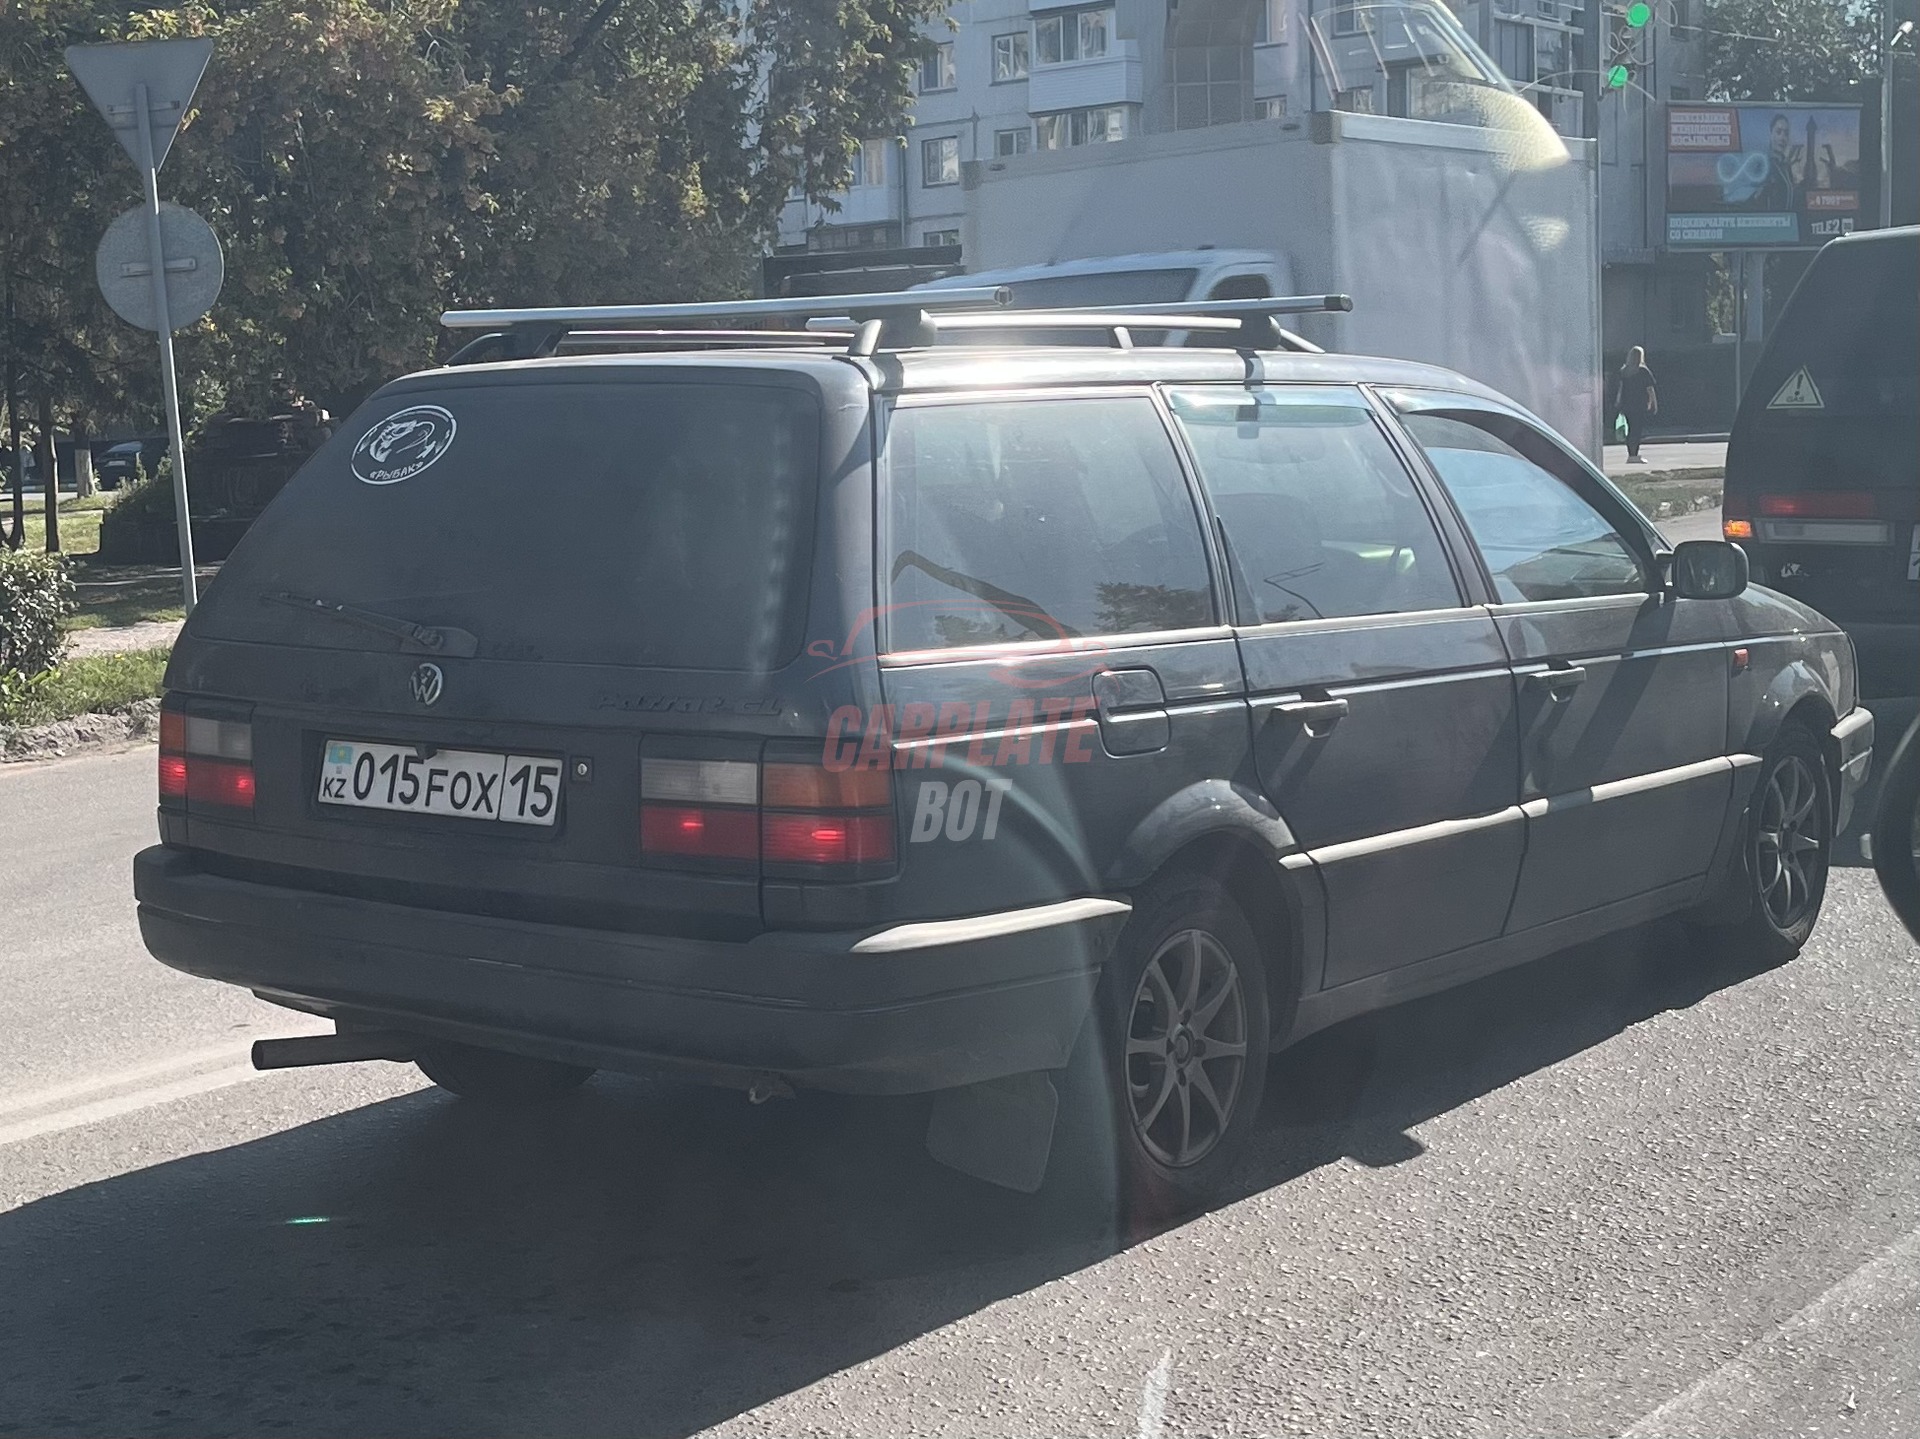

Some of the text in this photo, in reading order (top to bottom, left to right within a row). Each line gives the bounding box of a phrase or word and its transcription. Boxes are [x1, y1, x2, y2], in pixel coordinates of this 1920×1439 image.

[1811, 218, 1840, 235] TELE2
[322, 777, 347, 799] KZ
[509, 764, 559, 818] 15
